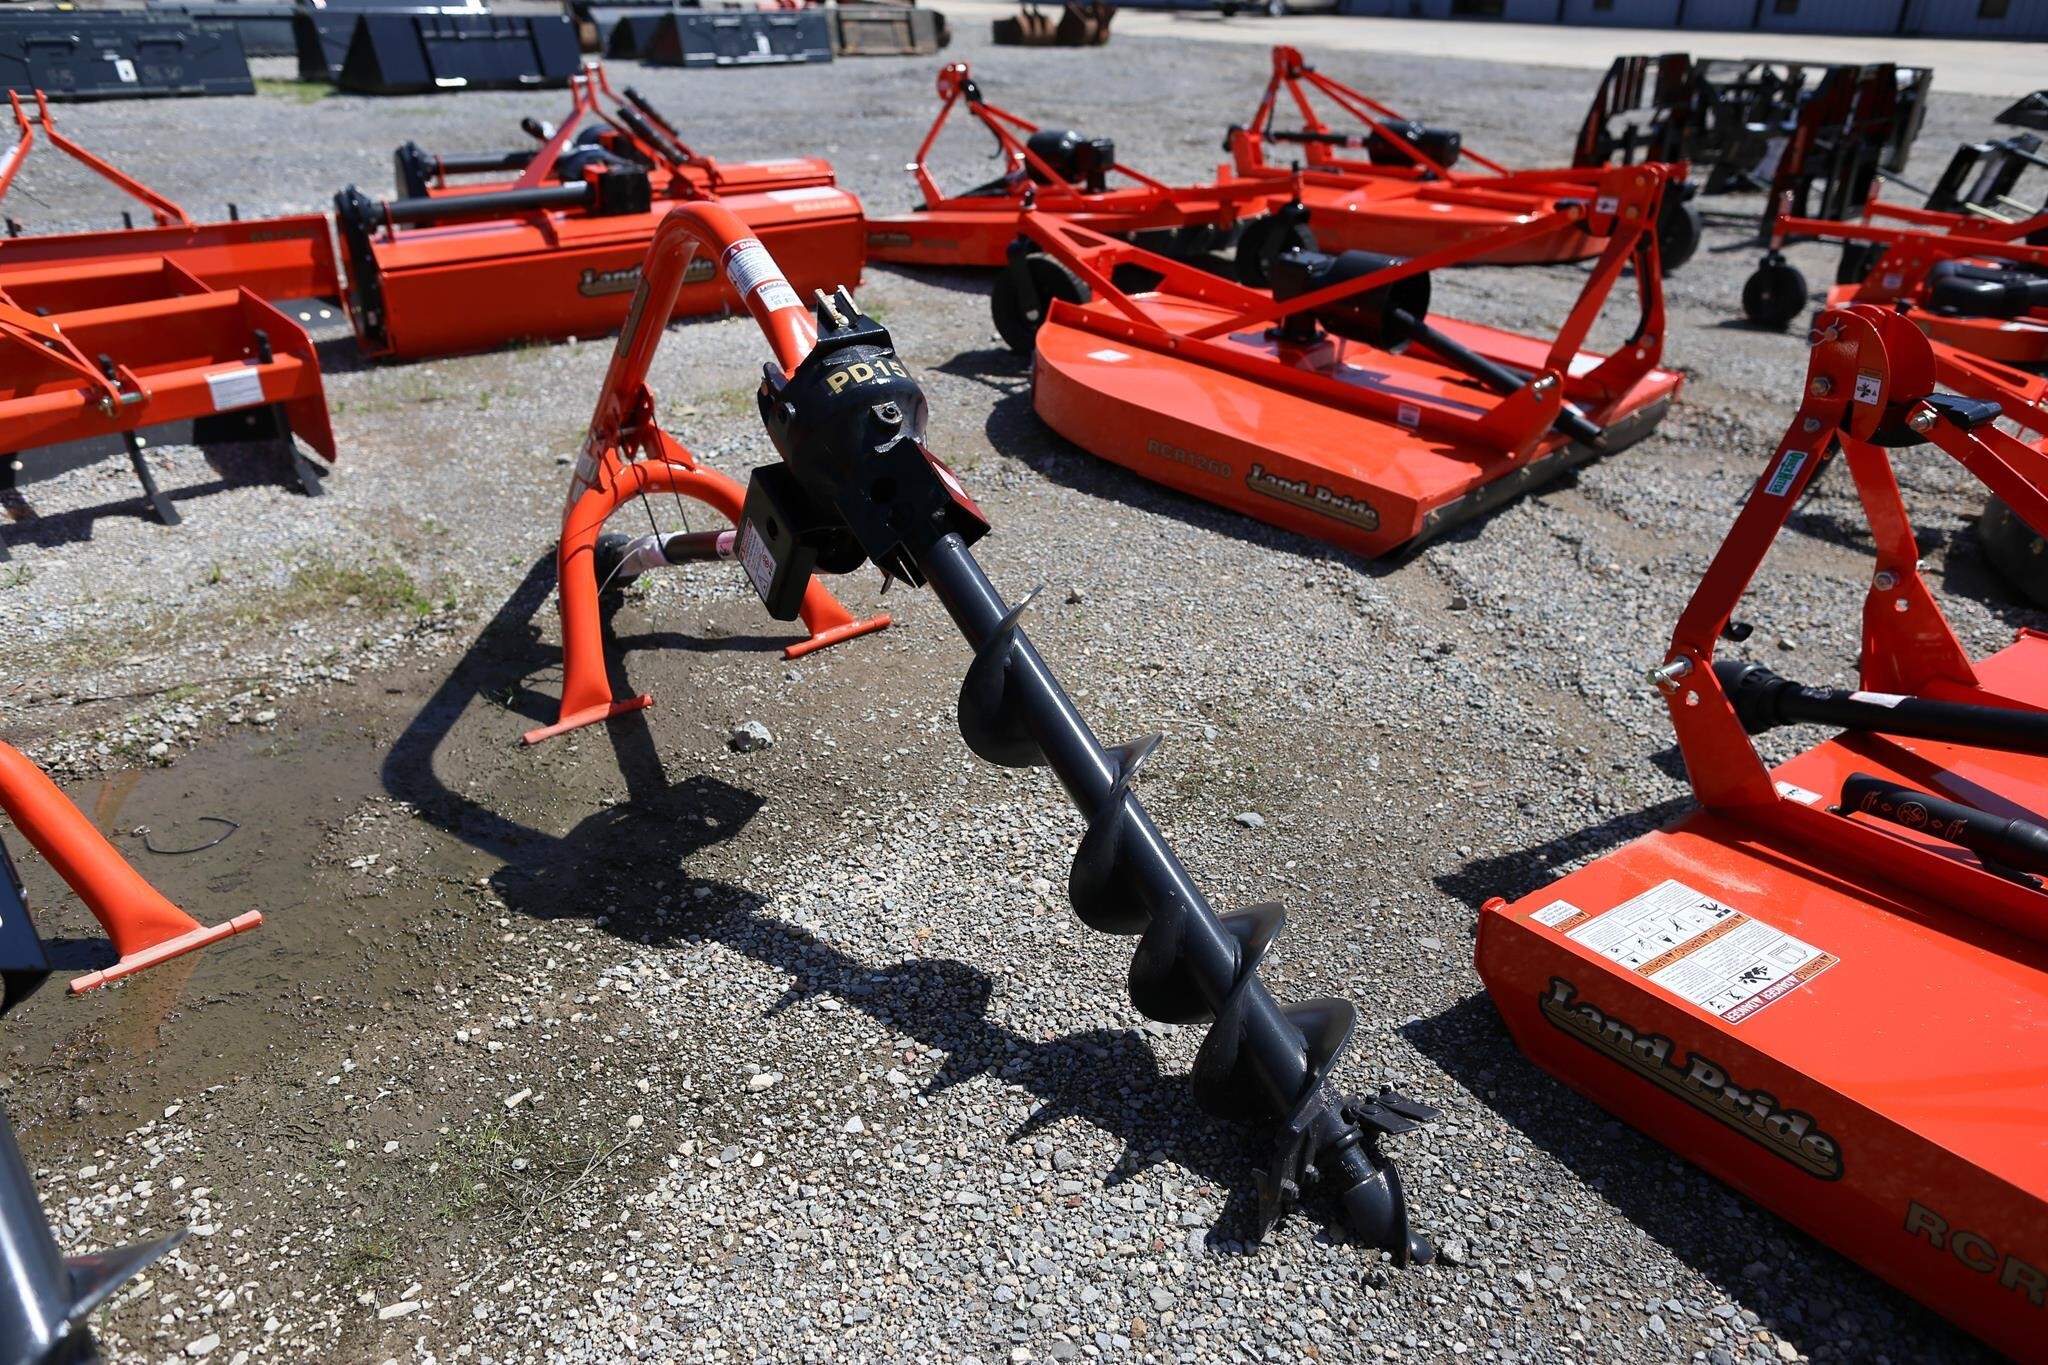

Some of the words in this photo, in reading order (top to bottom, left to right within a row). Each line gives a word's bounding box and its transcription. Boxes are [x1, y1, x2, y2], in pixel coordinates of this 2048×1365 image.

[826, 360, 907, 394] PD15
[1249, 464, 1309, 497] Land
[1314, 486, 1377, 521] Pride
[1723, 998, 1759, 1021] DANGER
[1760, 977, 1796, 1001] DANGER
[1545, 979, 1672, 1070] Land
[1680, 1056, 1836, 1163] Pride
[1904, 1199, 2048, 1308] RCR
